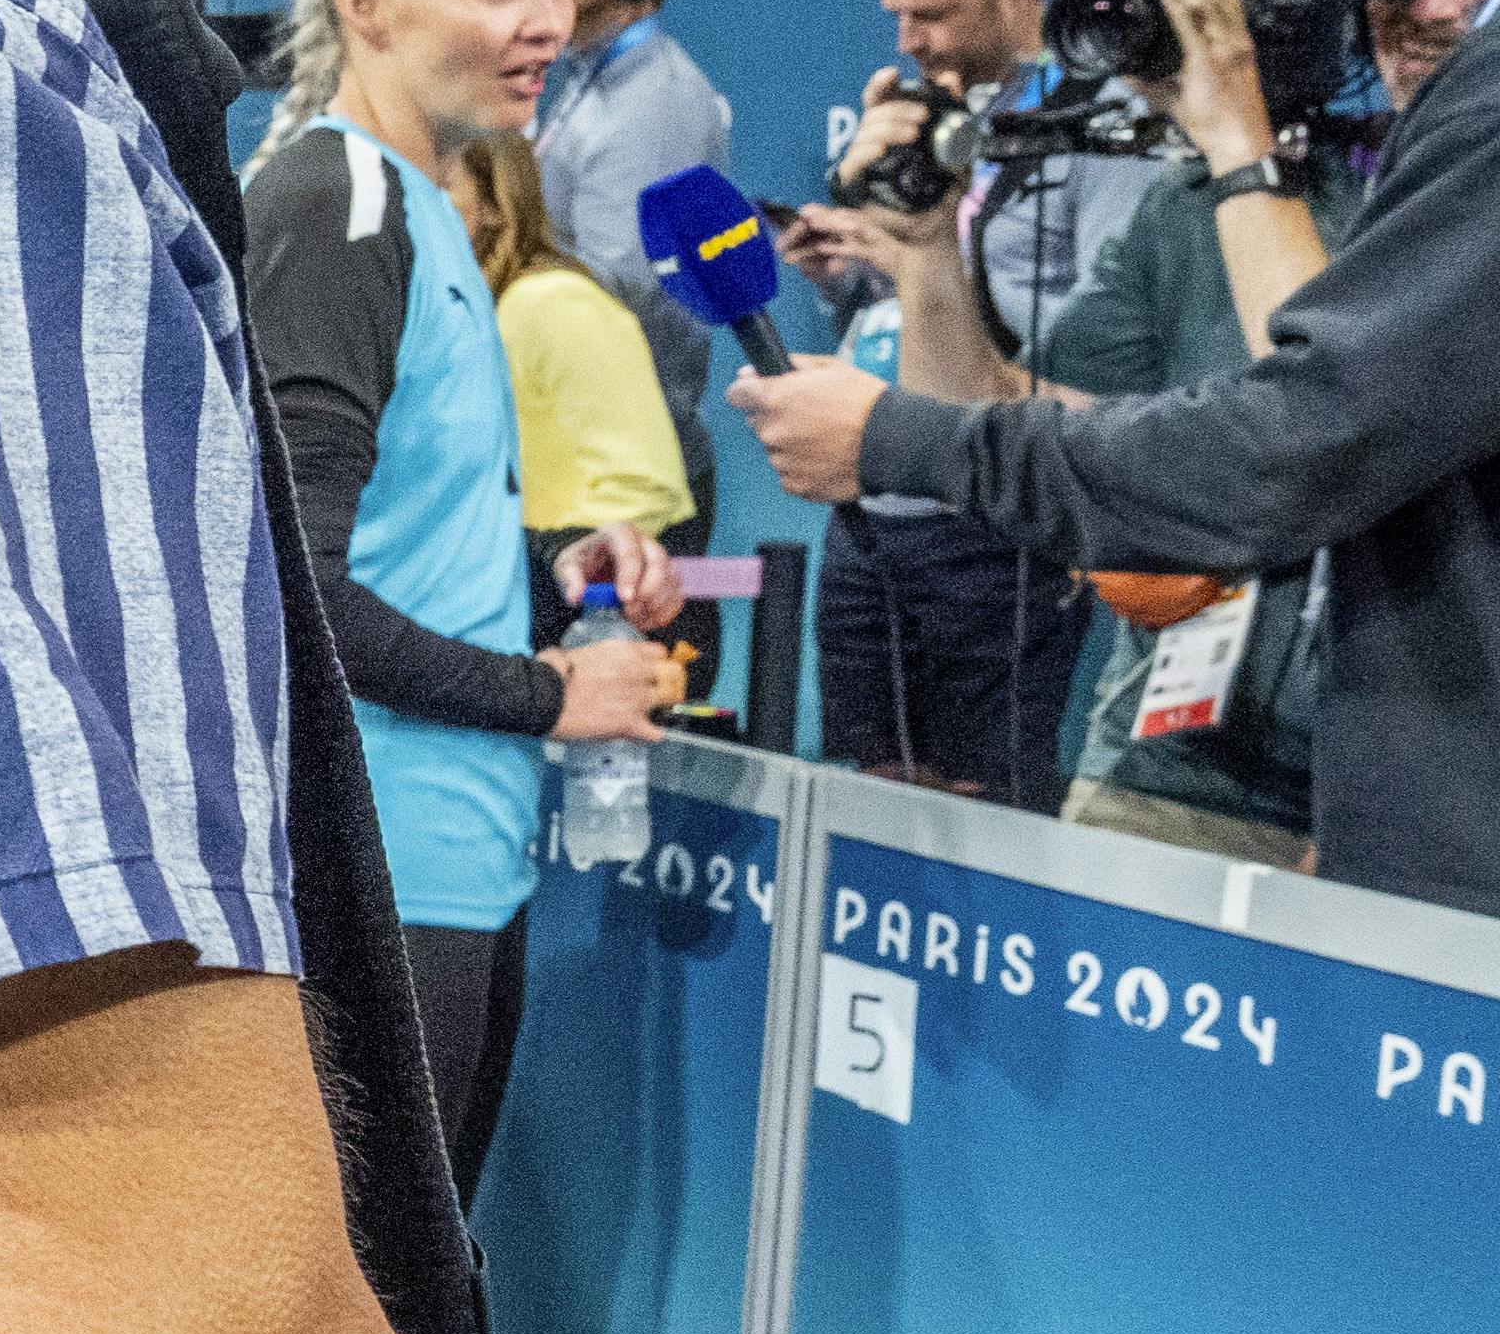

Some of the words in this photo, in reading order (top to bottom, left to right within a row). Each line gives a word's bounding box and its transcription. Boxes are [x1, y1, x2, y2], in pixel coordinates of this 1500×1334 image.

[831, 885, 1037, 998] PARIS
[1063, 950, 1278, 1067] 2024
[847, 992, 887, 1074] 5
